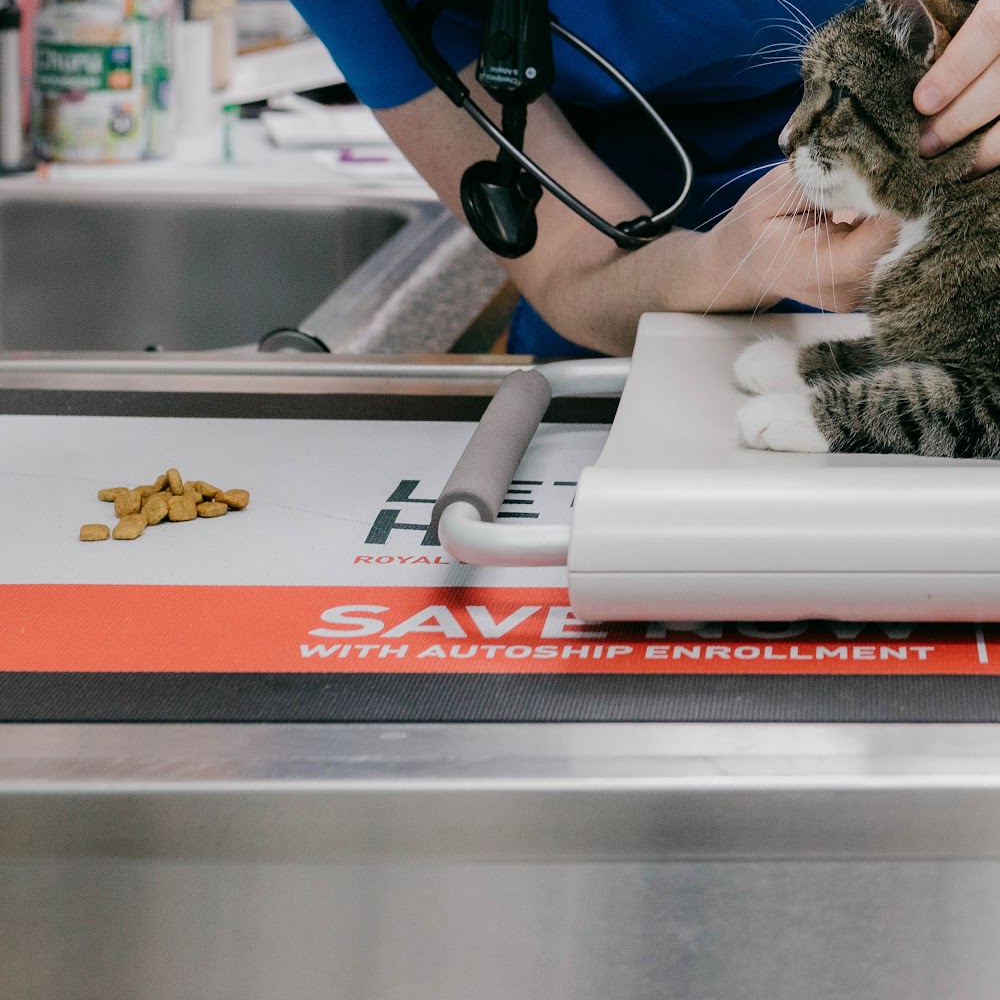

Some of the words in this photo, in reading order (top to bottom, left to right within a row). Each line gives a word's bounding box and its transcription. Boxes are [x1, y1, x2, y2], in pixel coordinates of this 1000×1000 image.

[354, 556, 449, 564] ROYAL
[308, 605, 607, 638] SAVE
[300, 645, 409, 659] WITH
[417, 645, 633, 659] AUTOSHIP
[645, 646, 934, 661] ENROLLMENT
